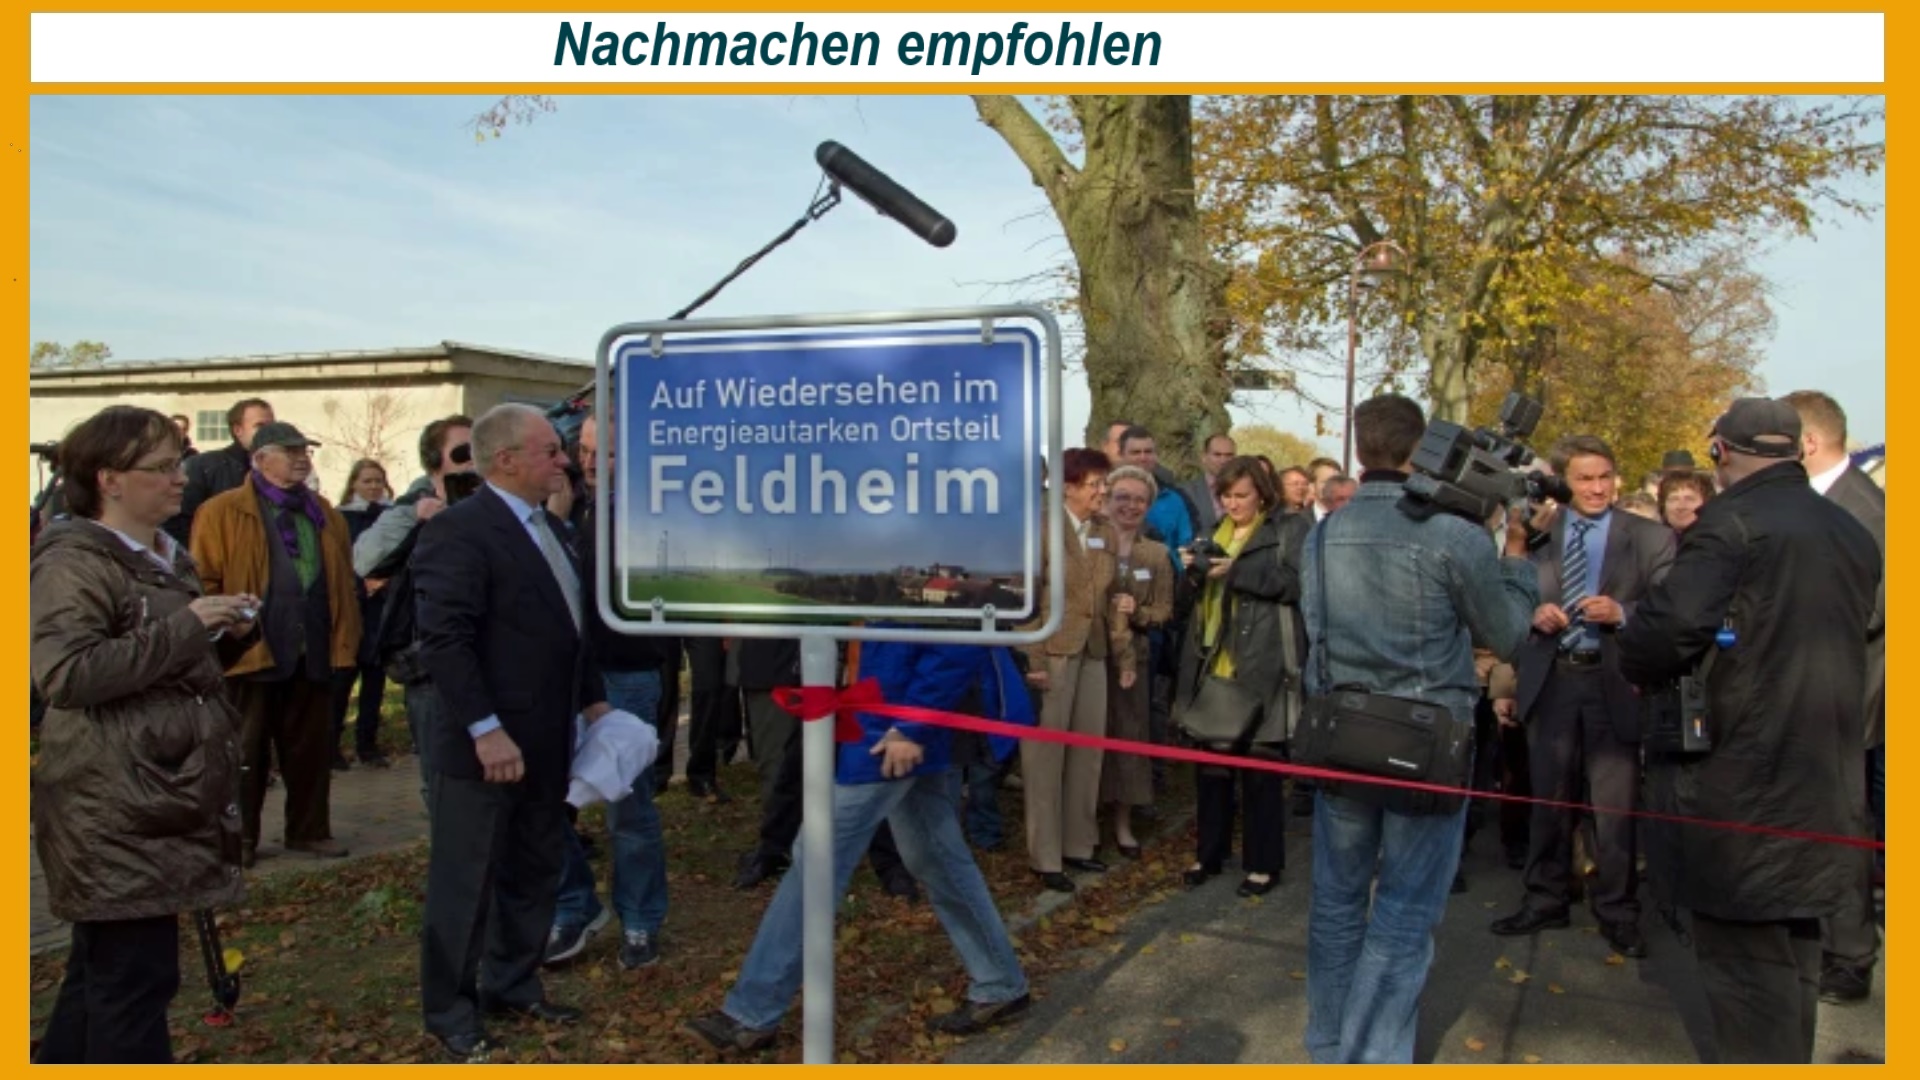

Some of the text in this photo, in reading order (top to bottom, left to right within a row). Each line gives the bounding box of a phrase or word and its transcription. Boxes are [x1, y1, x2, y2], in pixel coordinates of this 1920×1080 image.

[650, 372, 998, 410] Auf Wiedersehen im
[649, 414, 1001, 451] Energieautarken Ortsteil
[649, 452, 1000, 515] Feldheim
